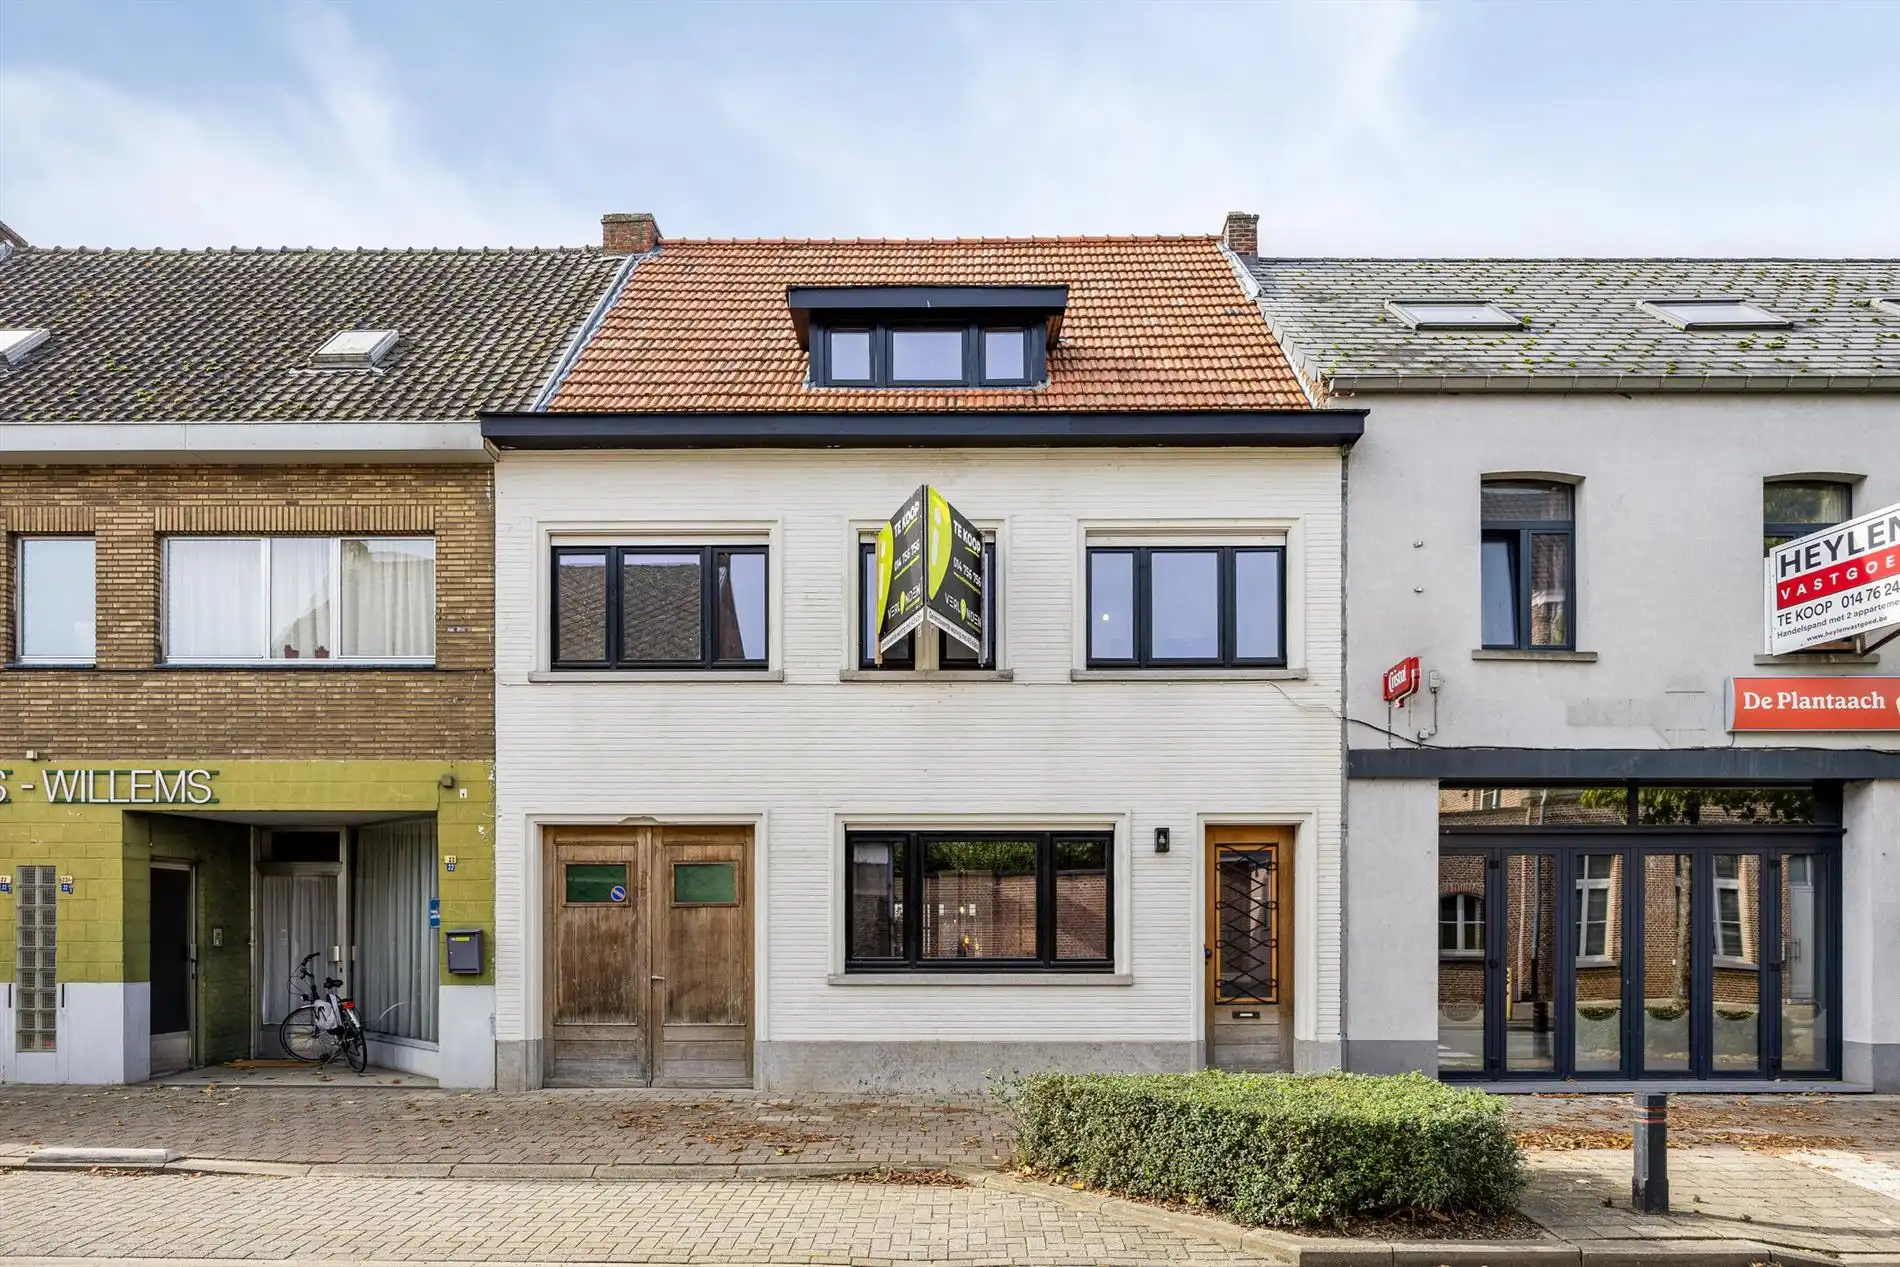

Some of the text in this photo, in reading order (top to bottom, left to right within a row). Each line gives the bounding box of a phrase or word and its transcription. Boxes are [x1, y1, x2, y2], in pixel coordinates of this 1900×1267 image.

[894, 501, 920, 538] TE KOOP
[953, 519, 981, 554] TE KOOP
[1777, 580, 1900, 627] TE KOOP 014 76 24
[1777, 619, 1827, 639] Handelspand
[1828, 614, 1845, 624] met
[1846, 611, 1852, 619] 2
[1806, 615, 1888, 642] www.heylenvastgoed.be
[1743, 690, 1886, 710] De Plantaach
[41, 769, 213, 804] WILLEMS
